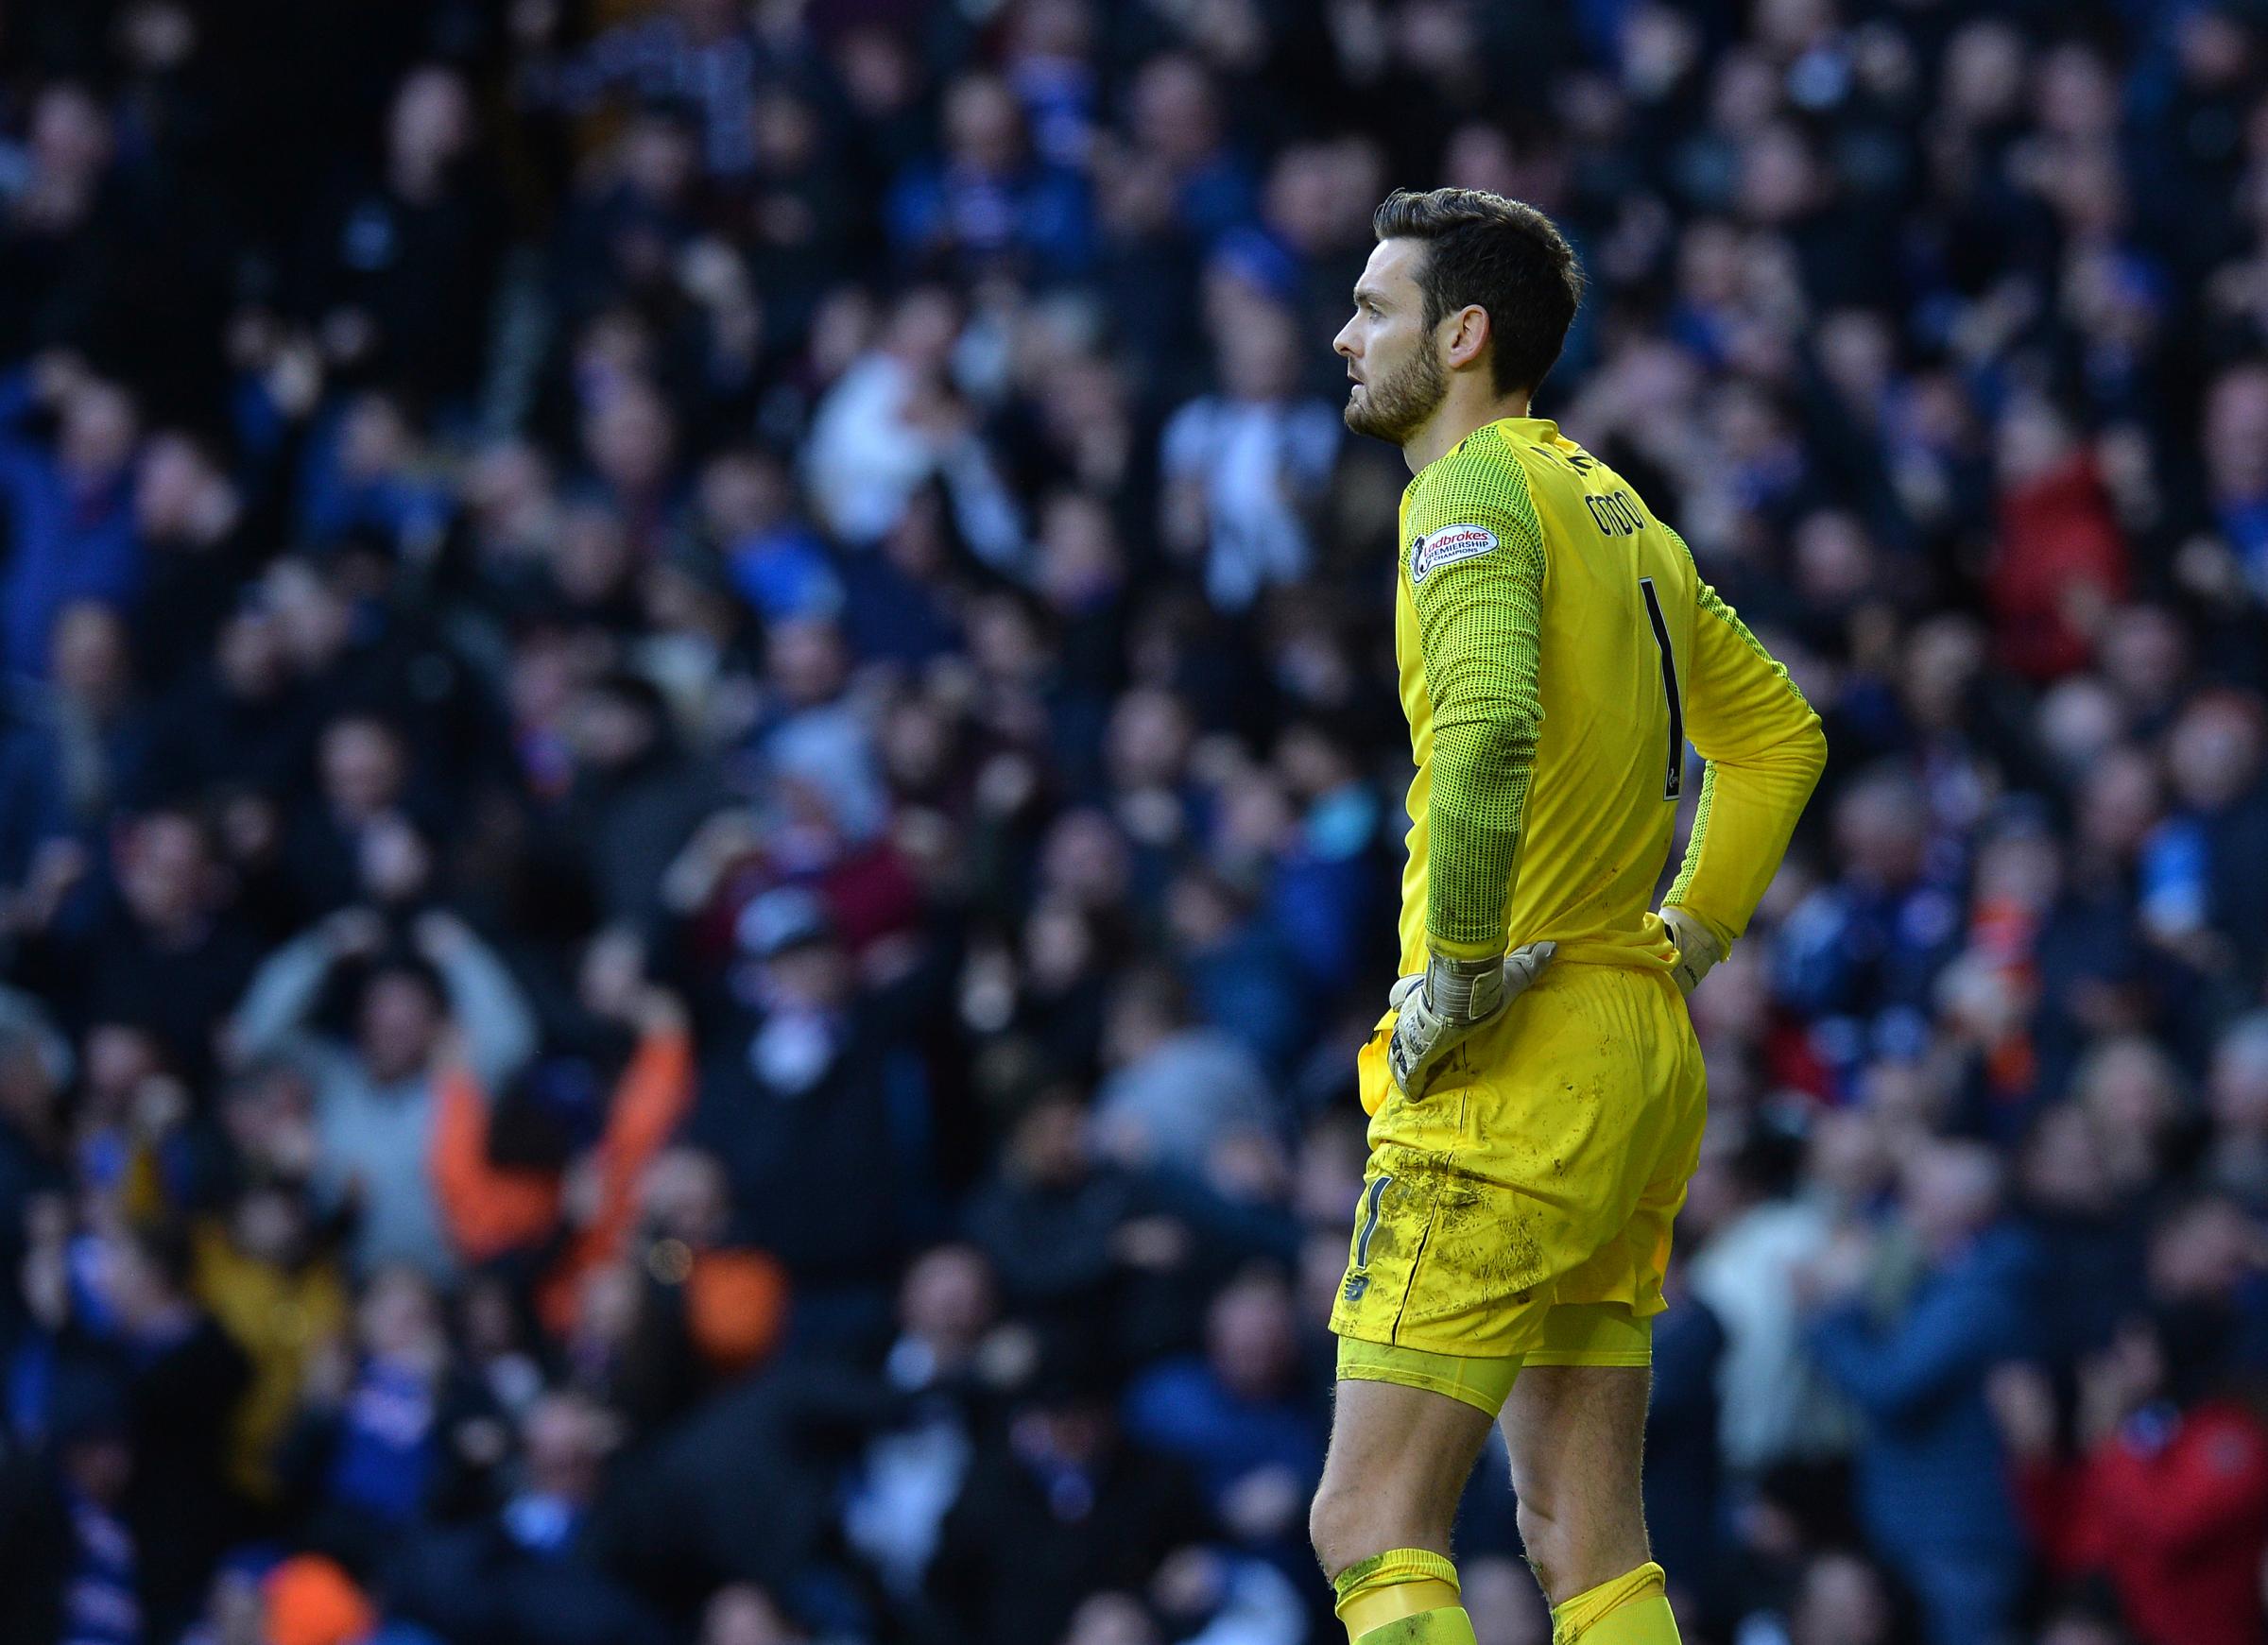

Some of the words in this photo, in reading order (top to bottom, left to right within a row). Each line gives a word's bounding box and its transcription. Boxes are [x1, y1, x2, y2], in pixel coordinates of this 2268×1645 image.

[1424, 531, 1488, 557] Ladbrokes
[1426, 540, 1489, 564] PREMIERSHIP
[1434, 548, 1479, 561] CHAMPIONS
[1639, 575, 1685, 803] 1
[1357, 1176, 1393, 1269] 1
